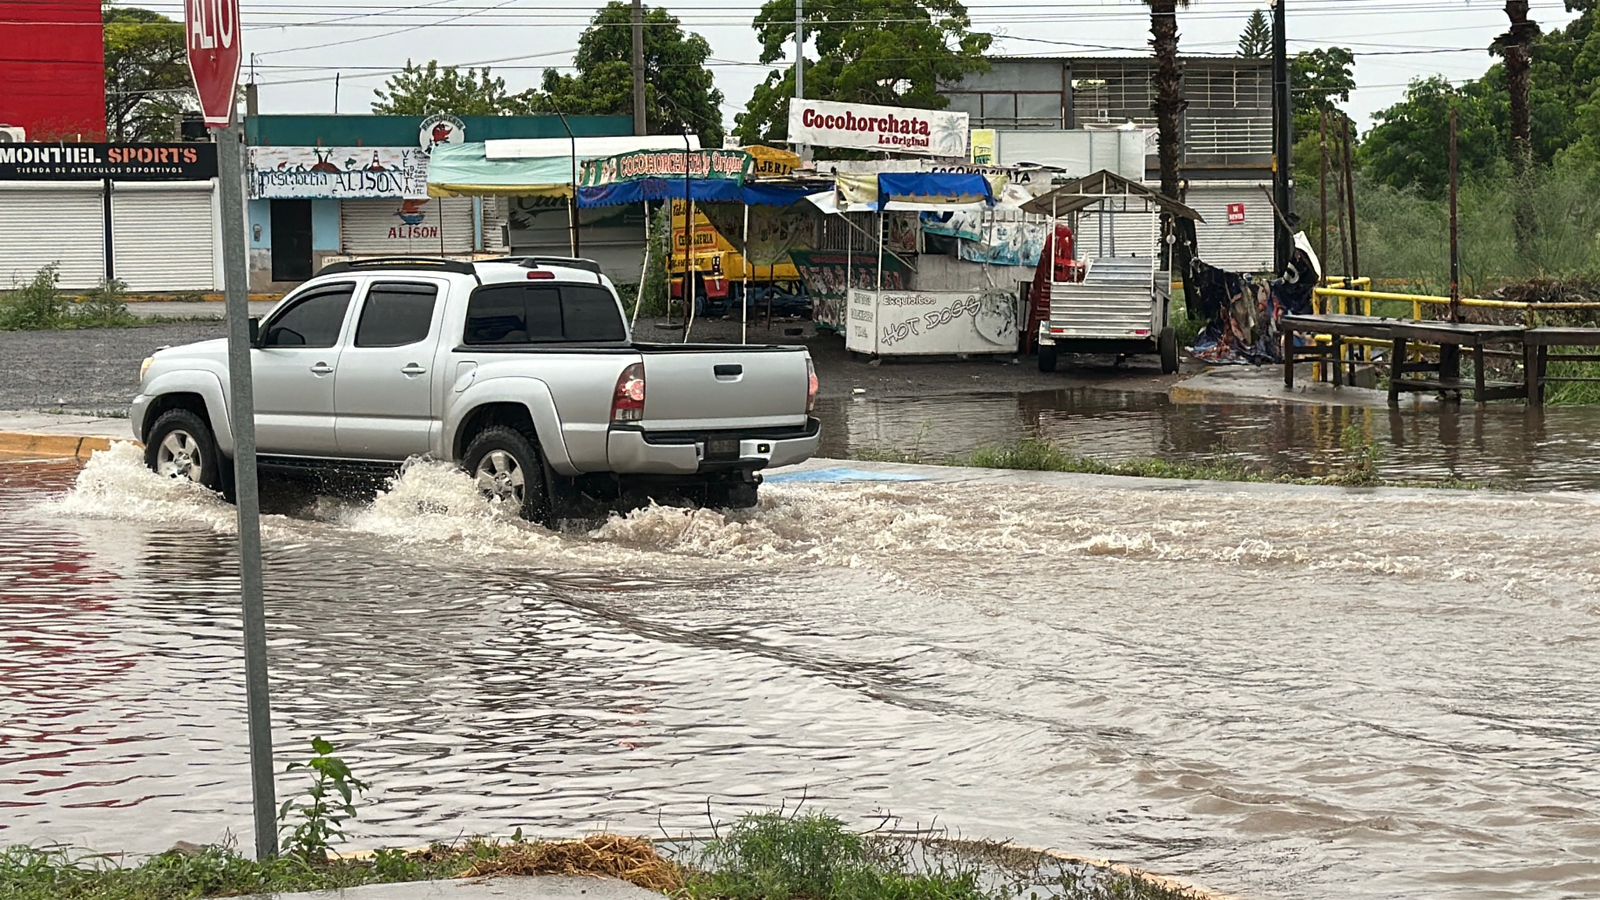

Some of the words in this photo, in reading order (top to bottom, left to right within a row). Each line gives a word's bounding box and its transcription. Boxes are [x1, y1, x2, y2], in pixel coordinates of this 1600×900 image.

[802, 108, 931, 136] Cocohorchata
[878, 134, 890, 144] La
[892, 136, 929, 147] Original
[0, 147, 101, 164] MONTIEL
[107, 147, 198, 164] SPORTS
[332, 171, 402, 193] ALISON
[388, 227, 438, 239] ALISON
[882, 295, 937, 307] Exquisitos
[881, 318, 920, 346] HOT
